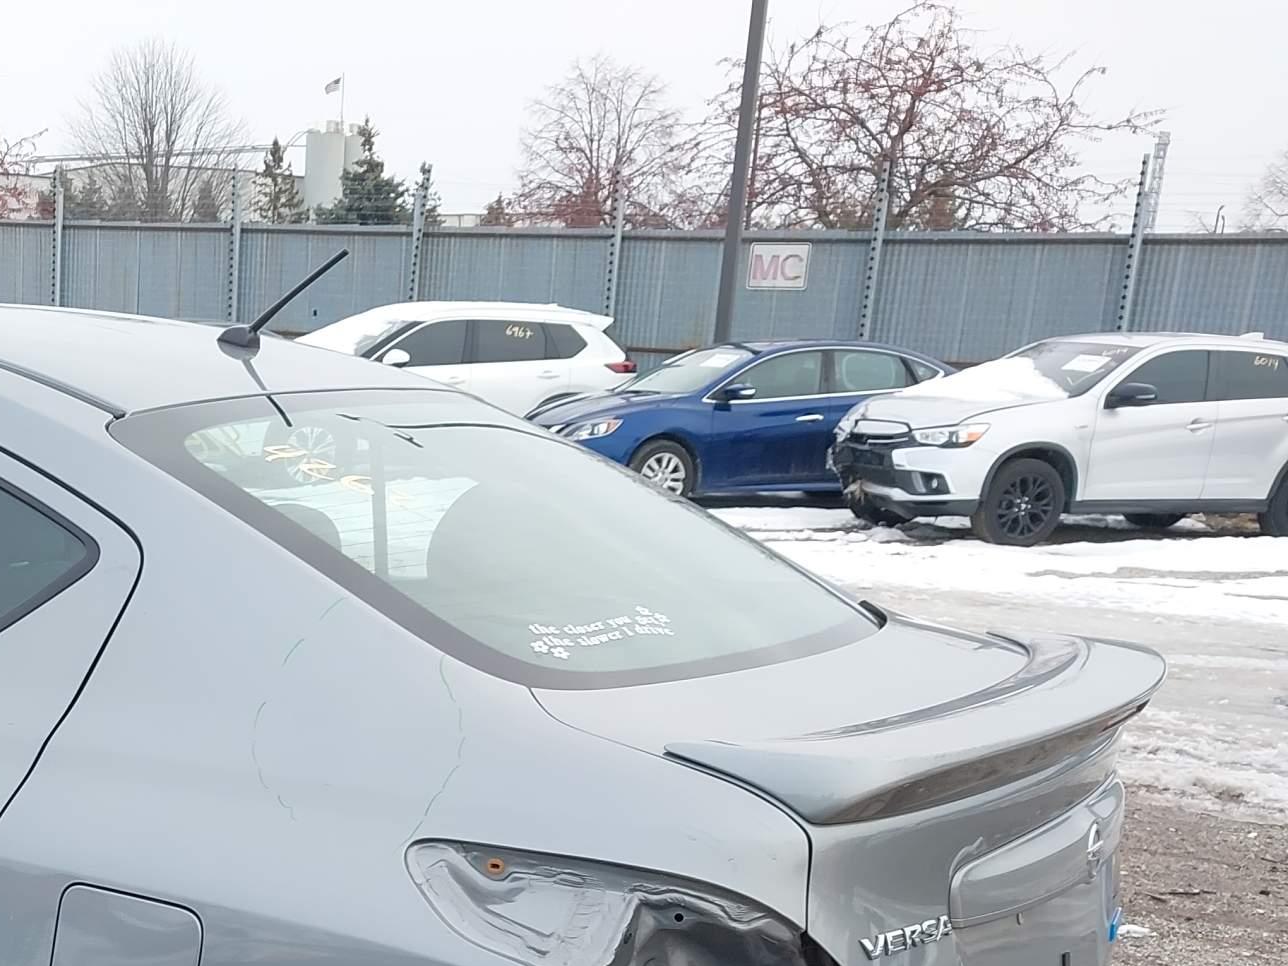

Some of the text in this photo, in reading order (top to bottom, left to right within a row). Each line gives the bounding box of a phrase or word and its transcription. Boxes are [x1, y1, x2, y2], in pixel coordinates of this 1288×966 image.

[752, 254, 804, 281] MC
[563, 620, 605, 635] closer
[576, 630, 623, 646] slower
[634, 623, 675, 635] drive
[858, 915, 952, 960] VERSA
